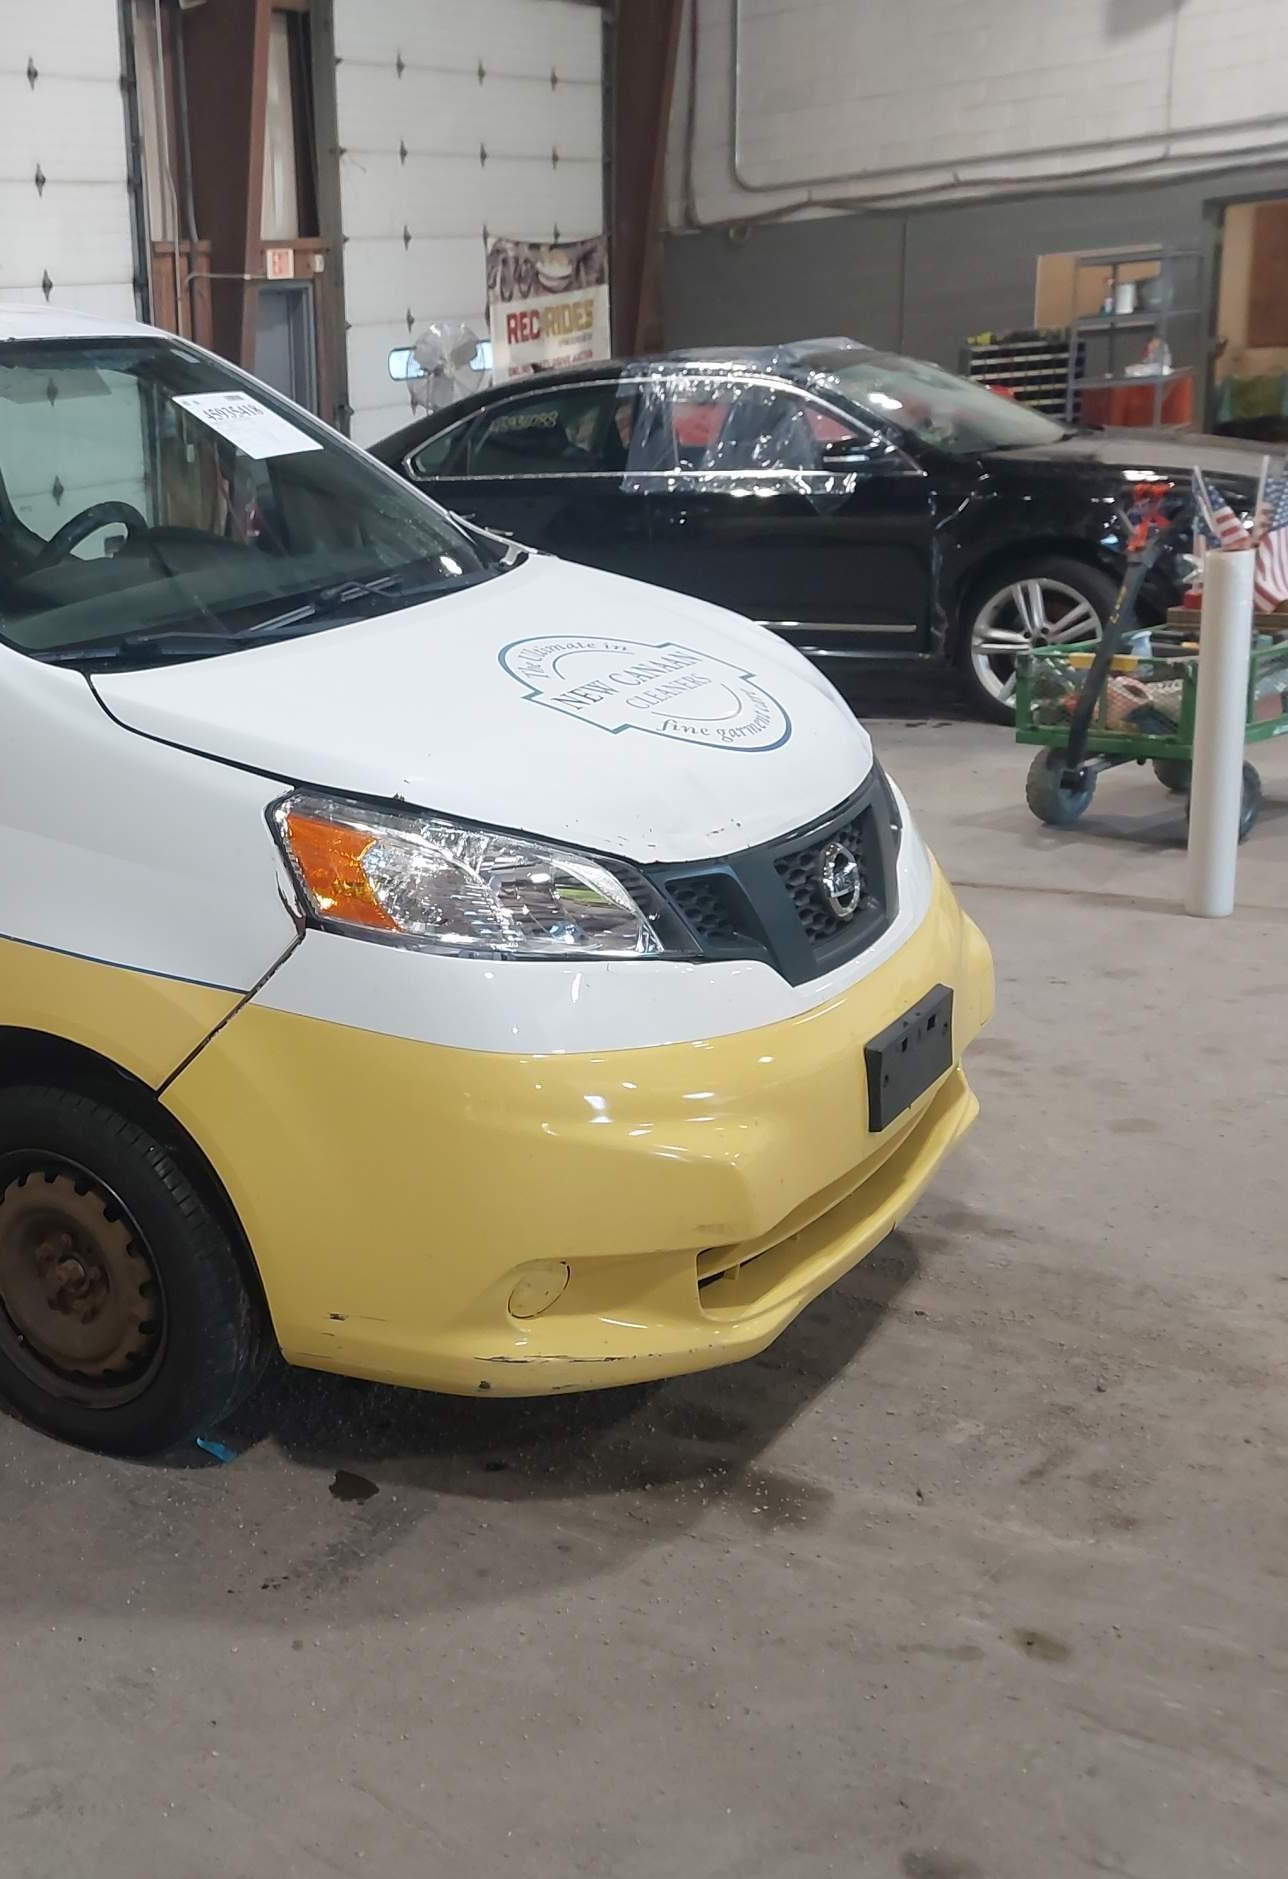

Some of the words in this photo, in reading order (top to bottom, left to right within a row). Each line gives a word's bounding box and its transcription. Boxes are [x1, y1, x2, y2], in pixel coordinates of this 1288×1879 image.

[549, 679, 620, 711] NEW
[608, 651, 704, 686] CANAAN
[625, 673, 713, 710] CLEANERS
[655, 718, 712, 736] fine
